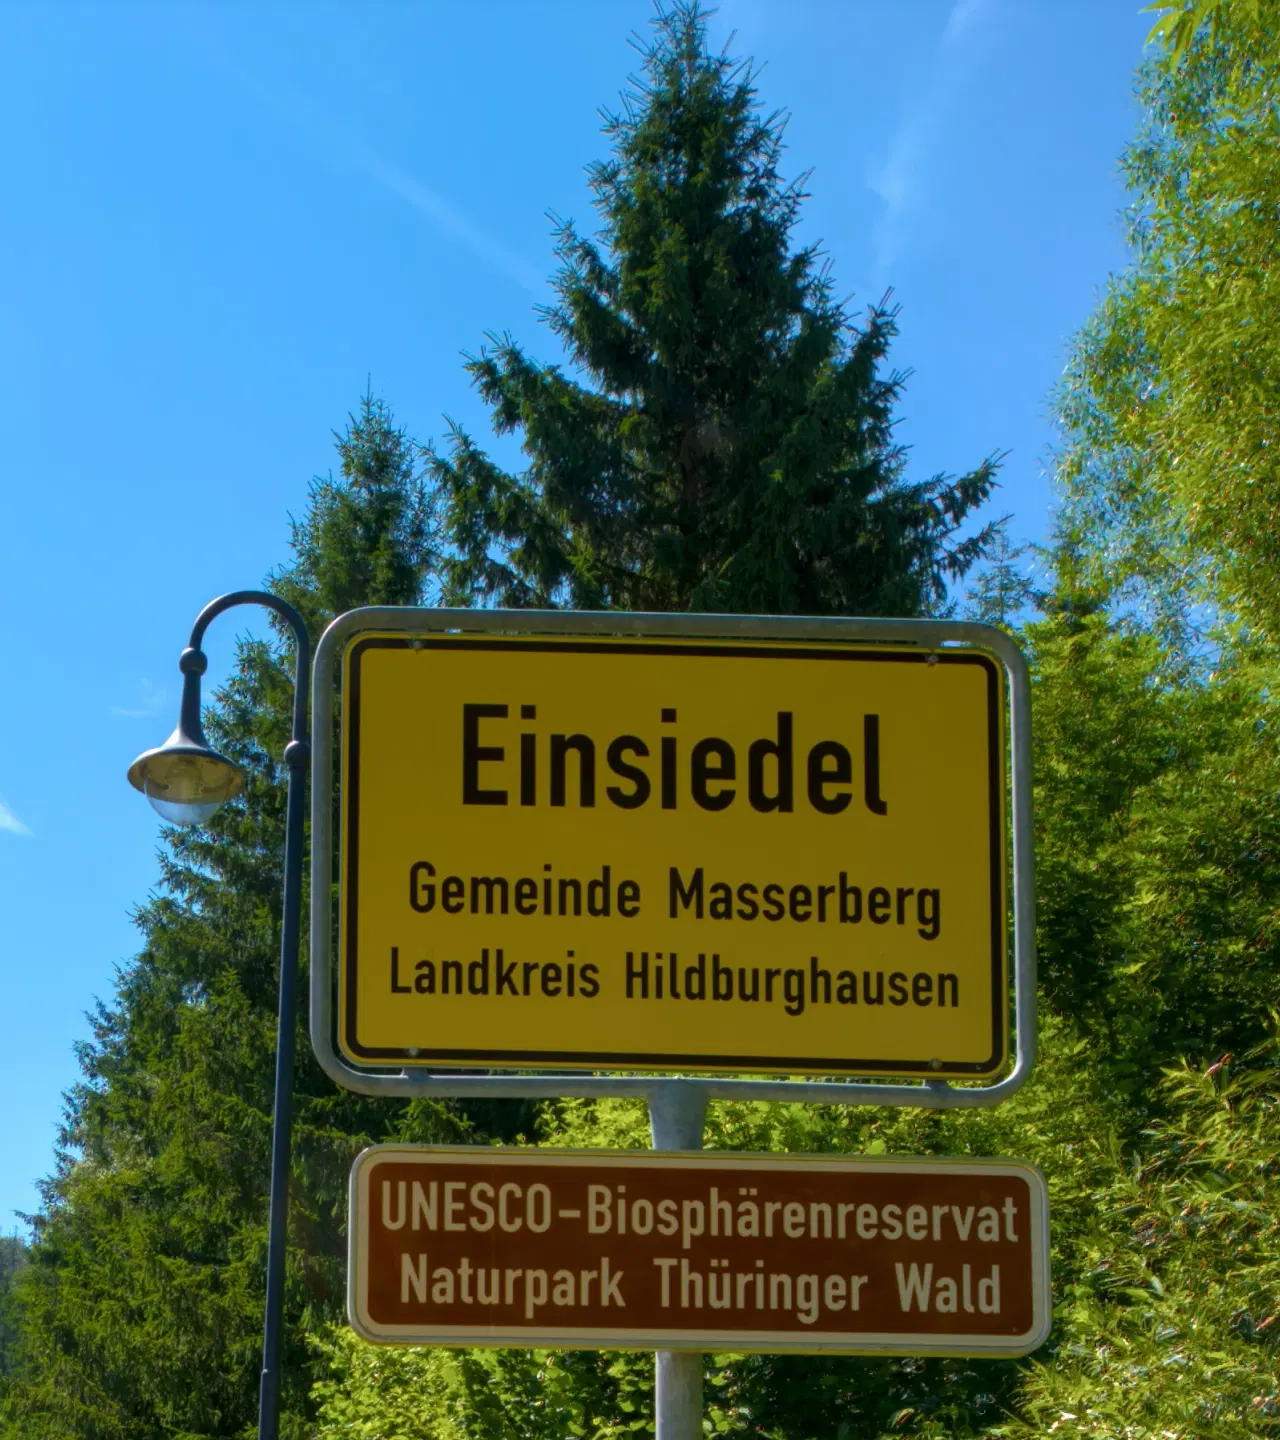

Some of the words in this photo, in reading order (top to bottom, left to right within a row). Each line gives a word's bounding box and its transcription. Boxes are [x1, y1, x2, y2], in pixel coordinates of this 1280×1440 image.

[463, 704, 887, 815] Einsiedel
[410, 861, 640, 917] Gemeinde
[670, 867, 940, 940] Masserberg
[391, 947, 599, 997] Landkreis
[626, 952, 958, 1016] Hildburghausen
[382, 1181, 1018, 1249] UNESCO-Biosphärenreservat
[401, 1253, 625, 1318] Naturpark
[654, 1258, 868, 1324] Thüringer
[895, 1263, 1000, 1313] Wald
